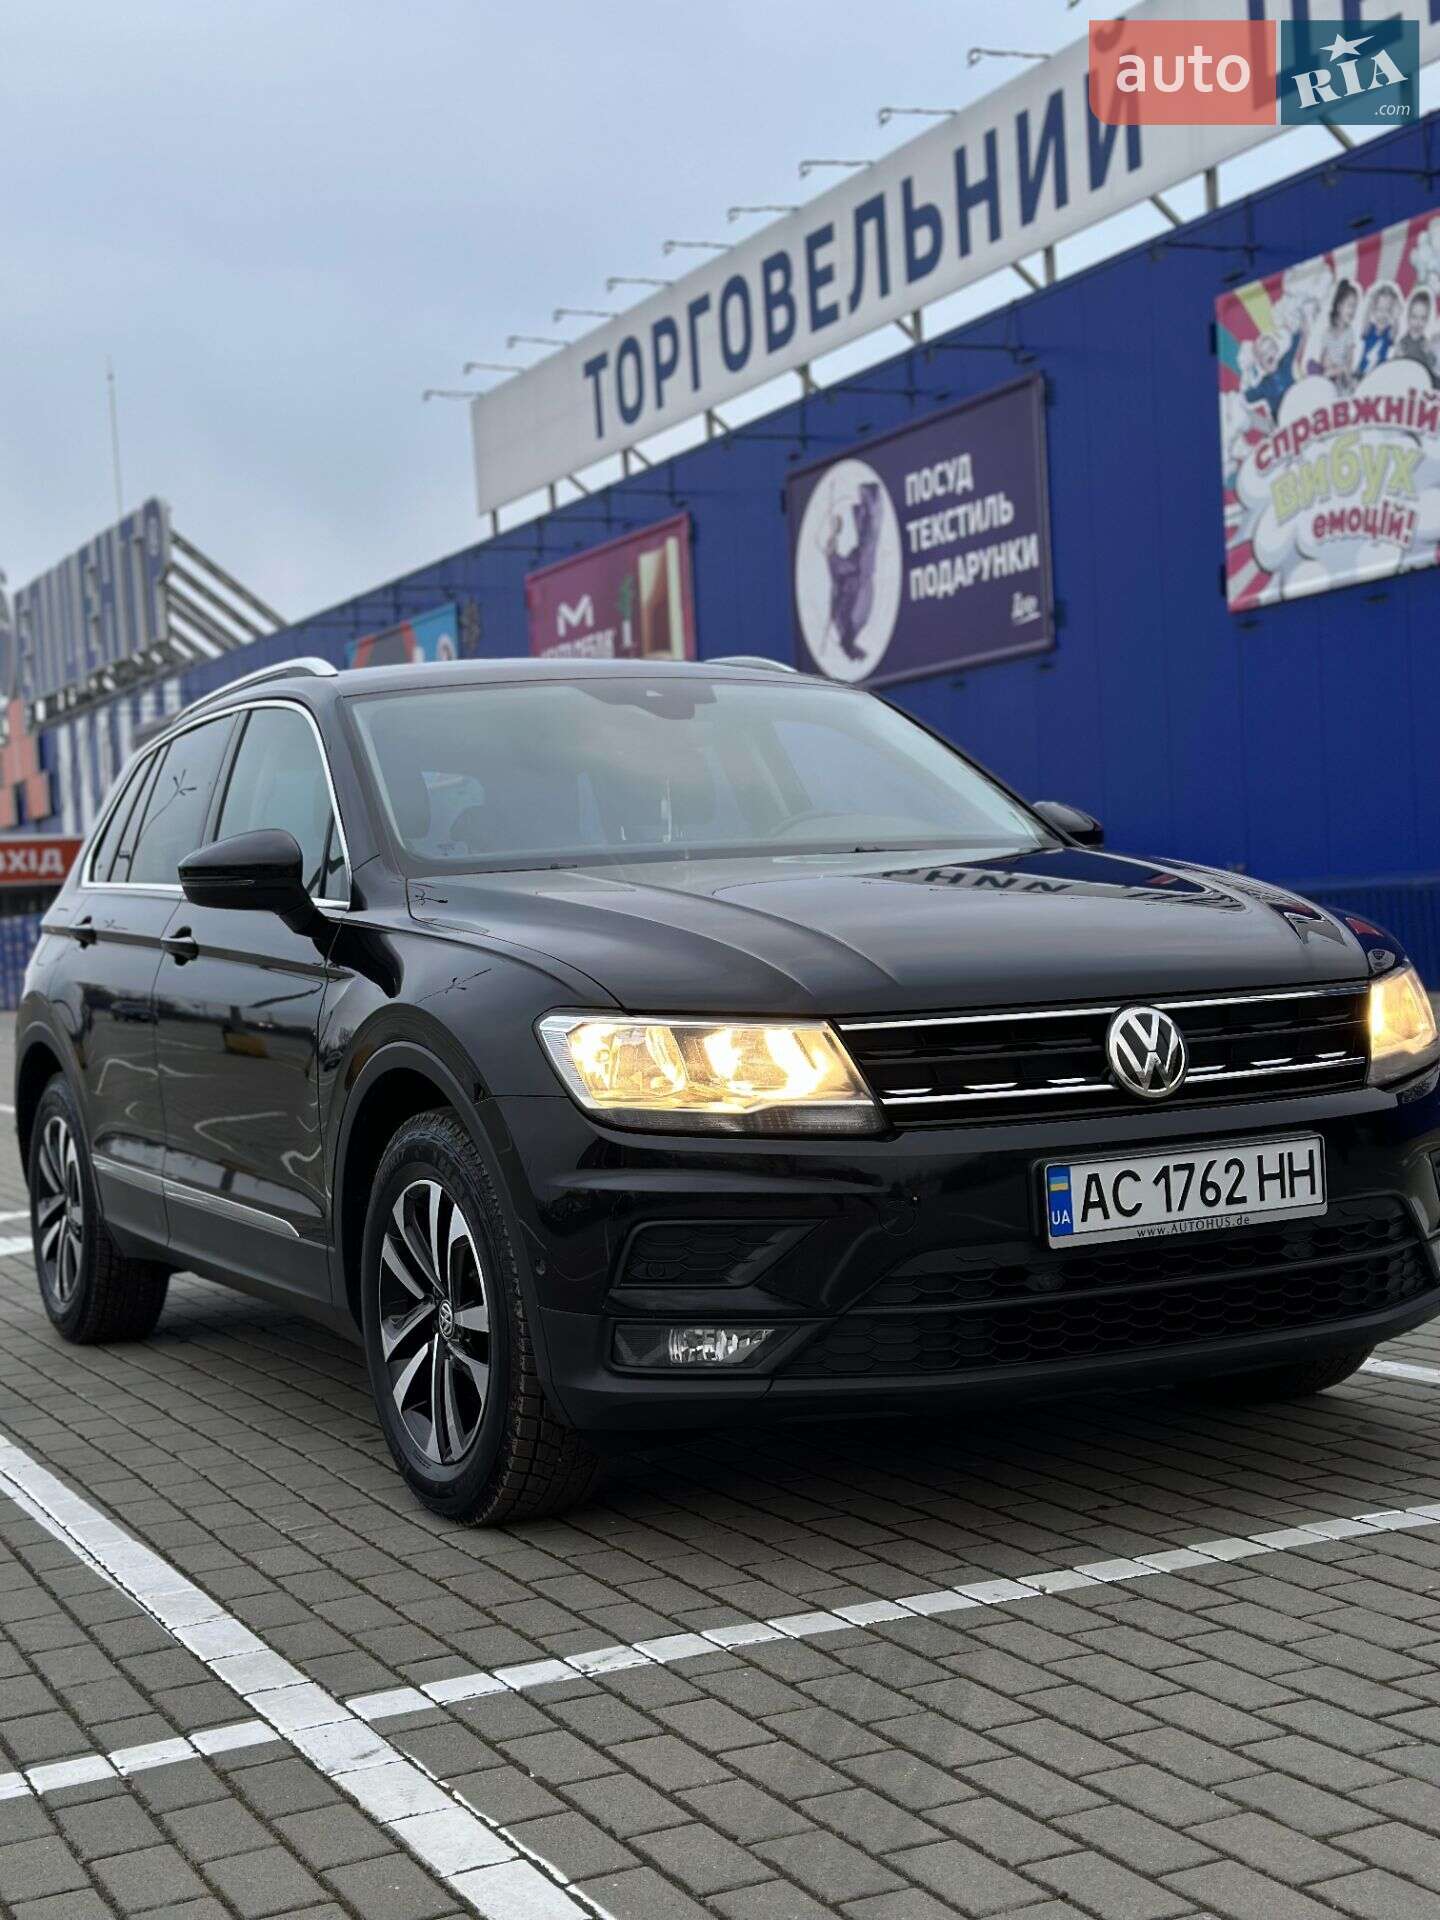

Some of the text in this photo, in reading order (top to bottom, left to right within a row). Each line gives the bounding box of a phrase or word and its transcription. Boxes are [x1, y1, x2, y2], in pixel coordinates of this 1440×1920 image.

[905, 453, 975, 507] ПОСУД
[1272, 430, 1423, 522] вибух
[906, 492, 1014, 553] ТЕКСТИЛЬ
[1312, 502, 1415, 545] емоцій!
[910, 534, 1040, 601] ПОДАРУНКИ
[1080, 1149, 1317, 1223] AC 1762 HH
[1051, 1210, 1071, 1226] UA
[1137, 1215, 1250, 1238] www.AUTOHUS.de
